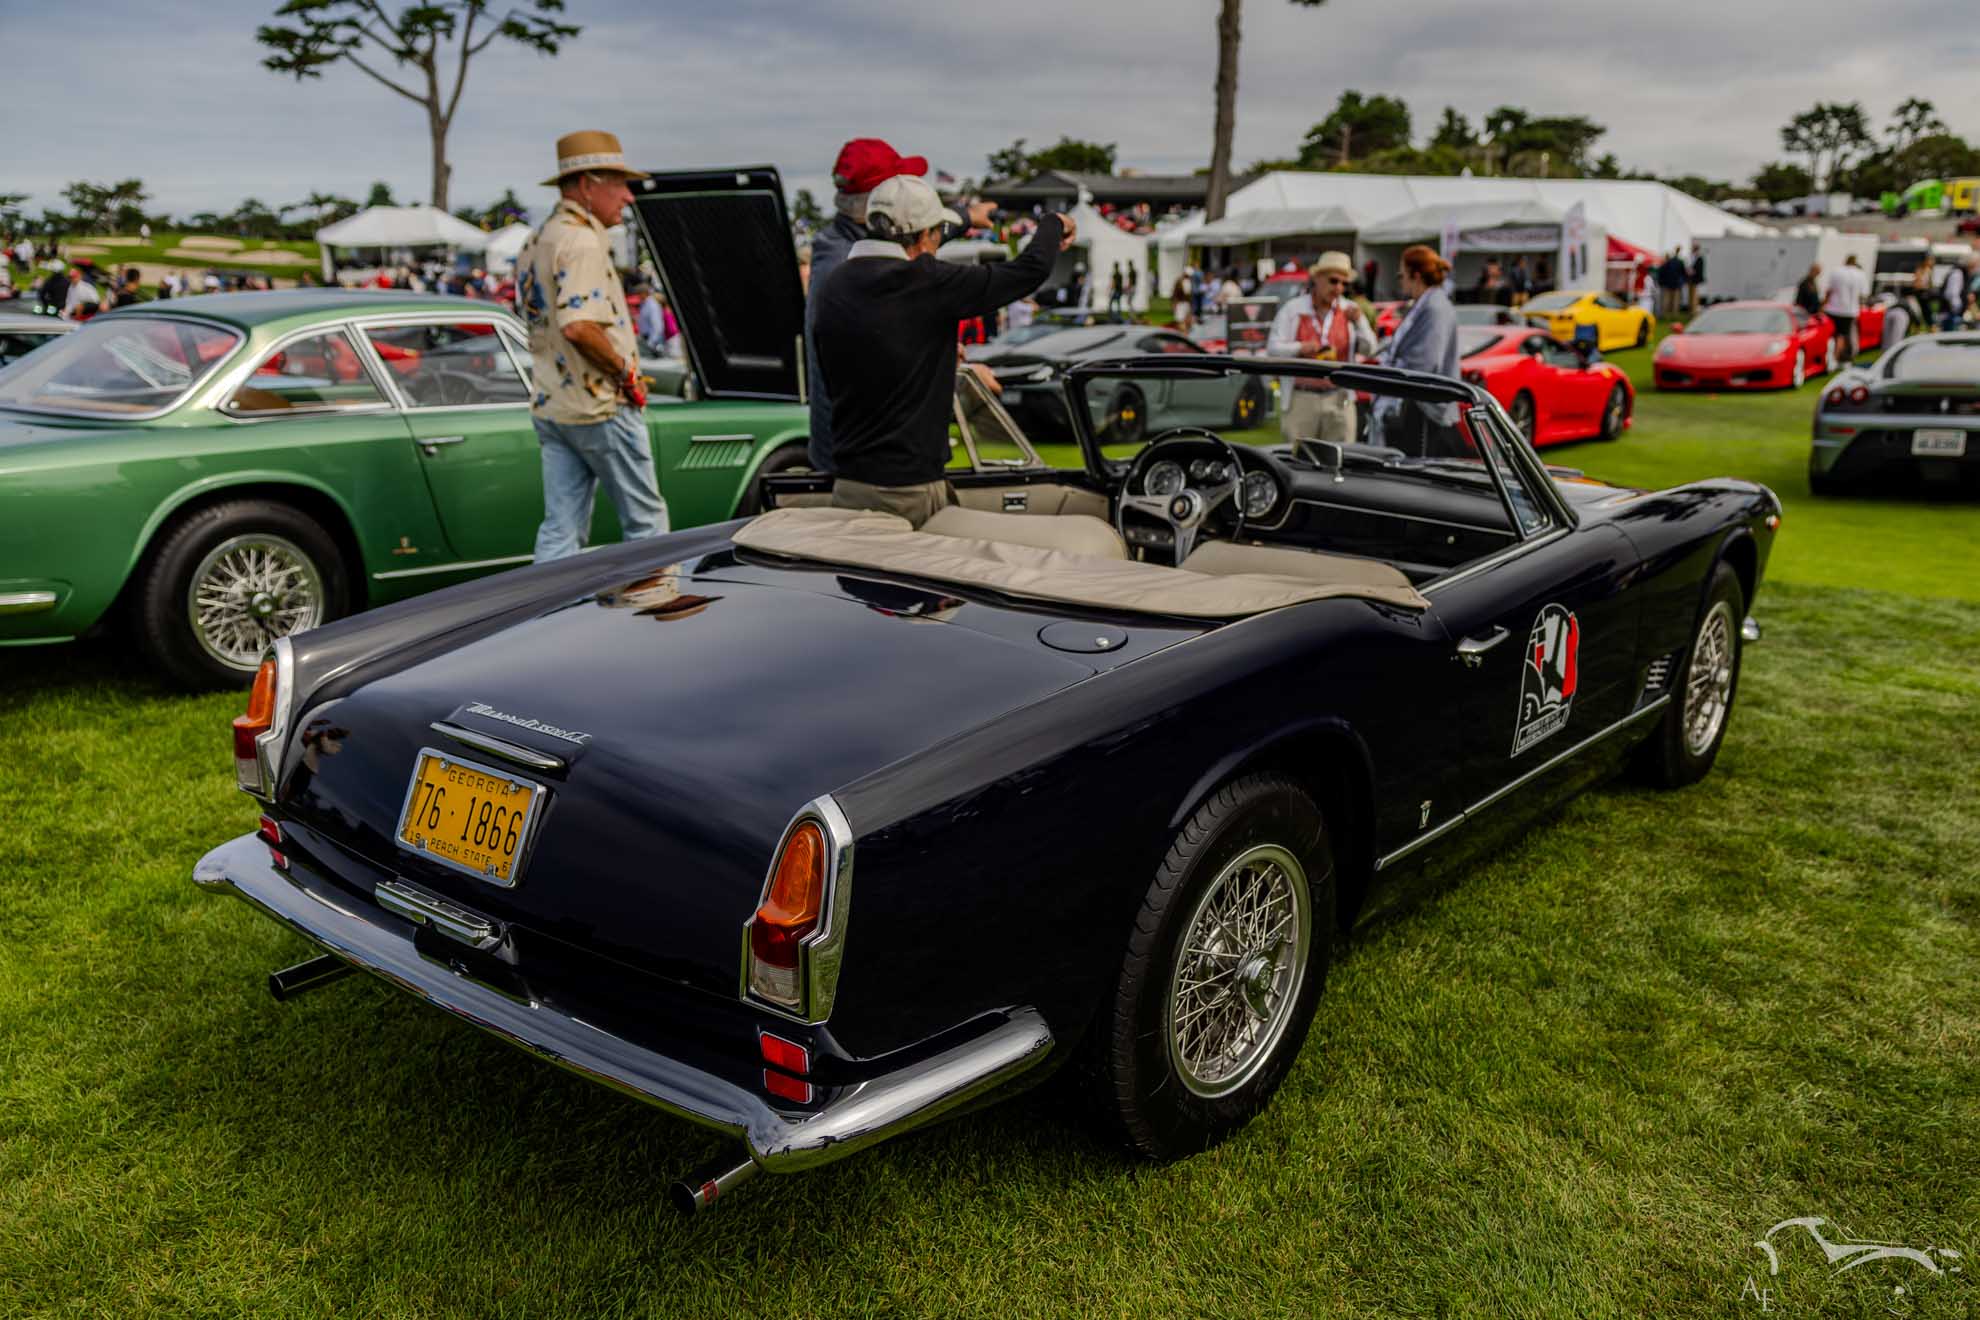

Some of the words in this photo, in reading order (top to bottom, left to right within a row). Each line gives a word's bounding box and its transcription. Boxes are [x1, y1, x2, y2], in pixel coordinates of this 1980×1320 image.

[448, 769, 510, 797] GEORGIA
[416, 782, 446, 830] 76
[460, 796, 523, 856] 1866
[430, 837, 460, 855] PEACH
[463, 848, 492, 866] STATE
